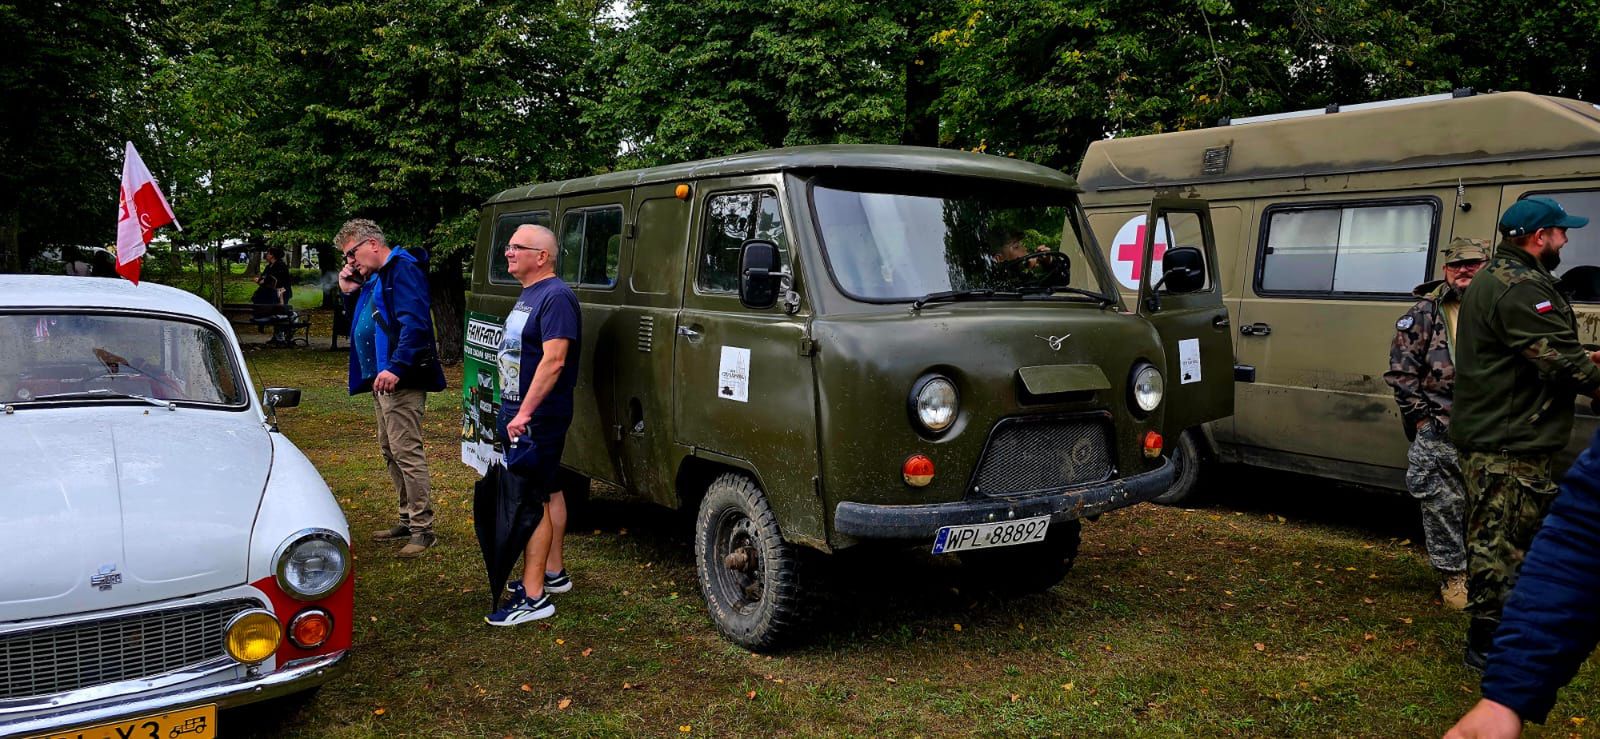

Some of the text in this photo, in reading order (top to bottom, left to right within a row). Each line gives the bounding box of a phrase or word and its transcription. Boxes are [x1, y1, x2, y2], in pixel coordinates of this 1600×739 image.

[469, 323, 501, 346] FANFARO
[947, 528, 981, 550] WPL
[990, 520, 1047, 545] 88892
